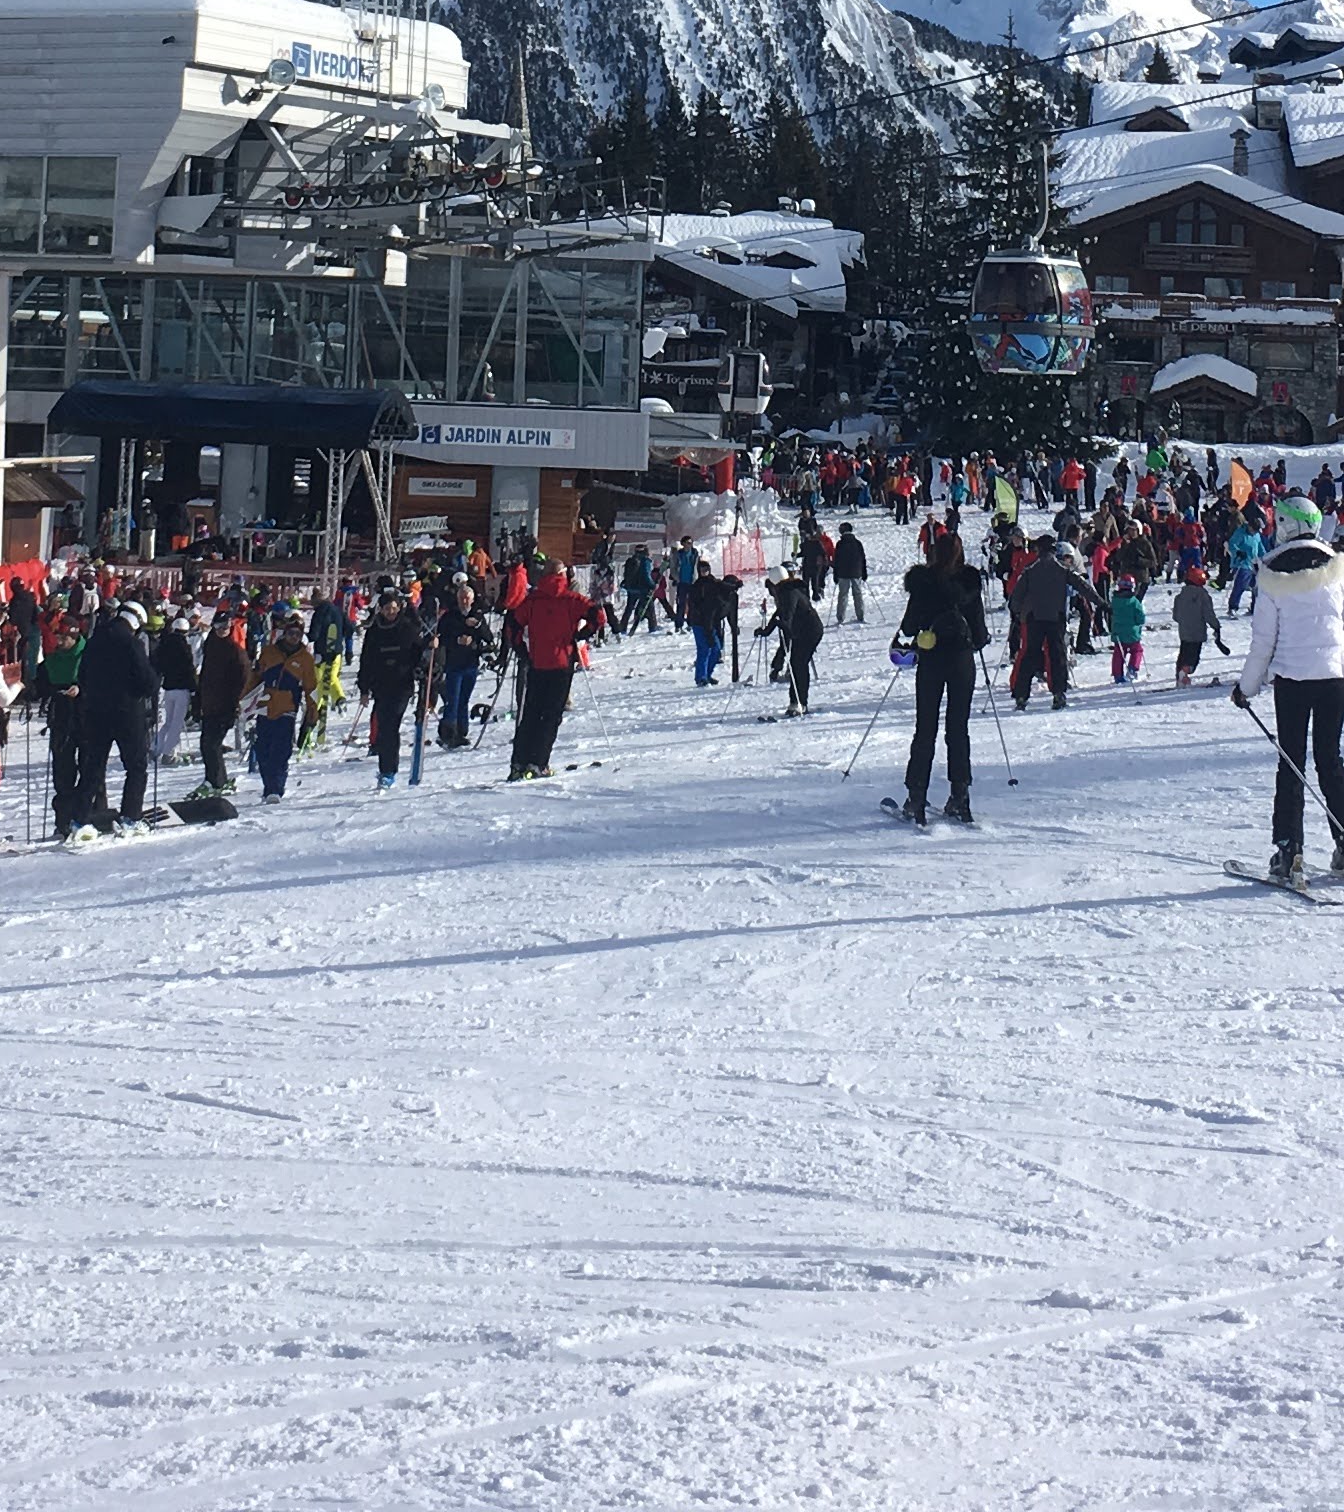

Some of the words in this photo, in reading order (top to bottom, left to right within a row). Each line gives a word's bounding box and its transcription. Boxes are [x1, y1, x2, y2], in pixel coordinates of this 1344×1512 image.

[1191, 322, 1235, 334] DENALI
[445, 427, 502, 444] JARDIN
[505, 429, 551, 446] ALPIN
